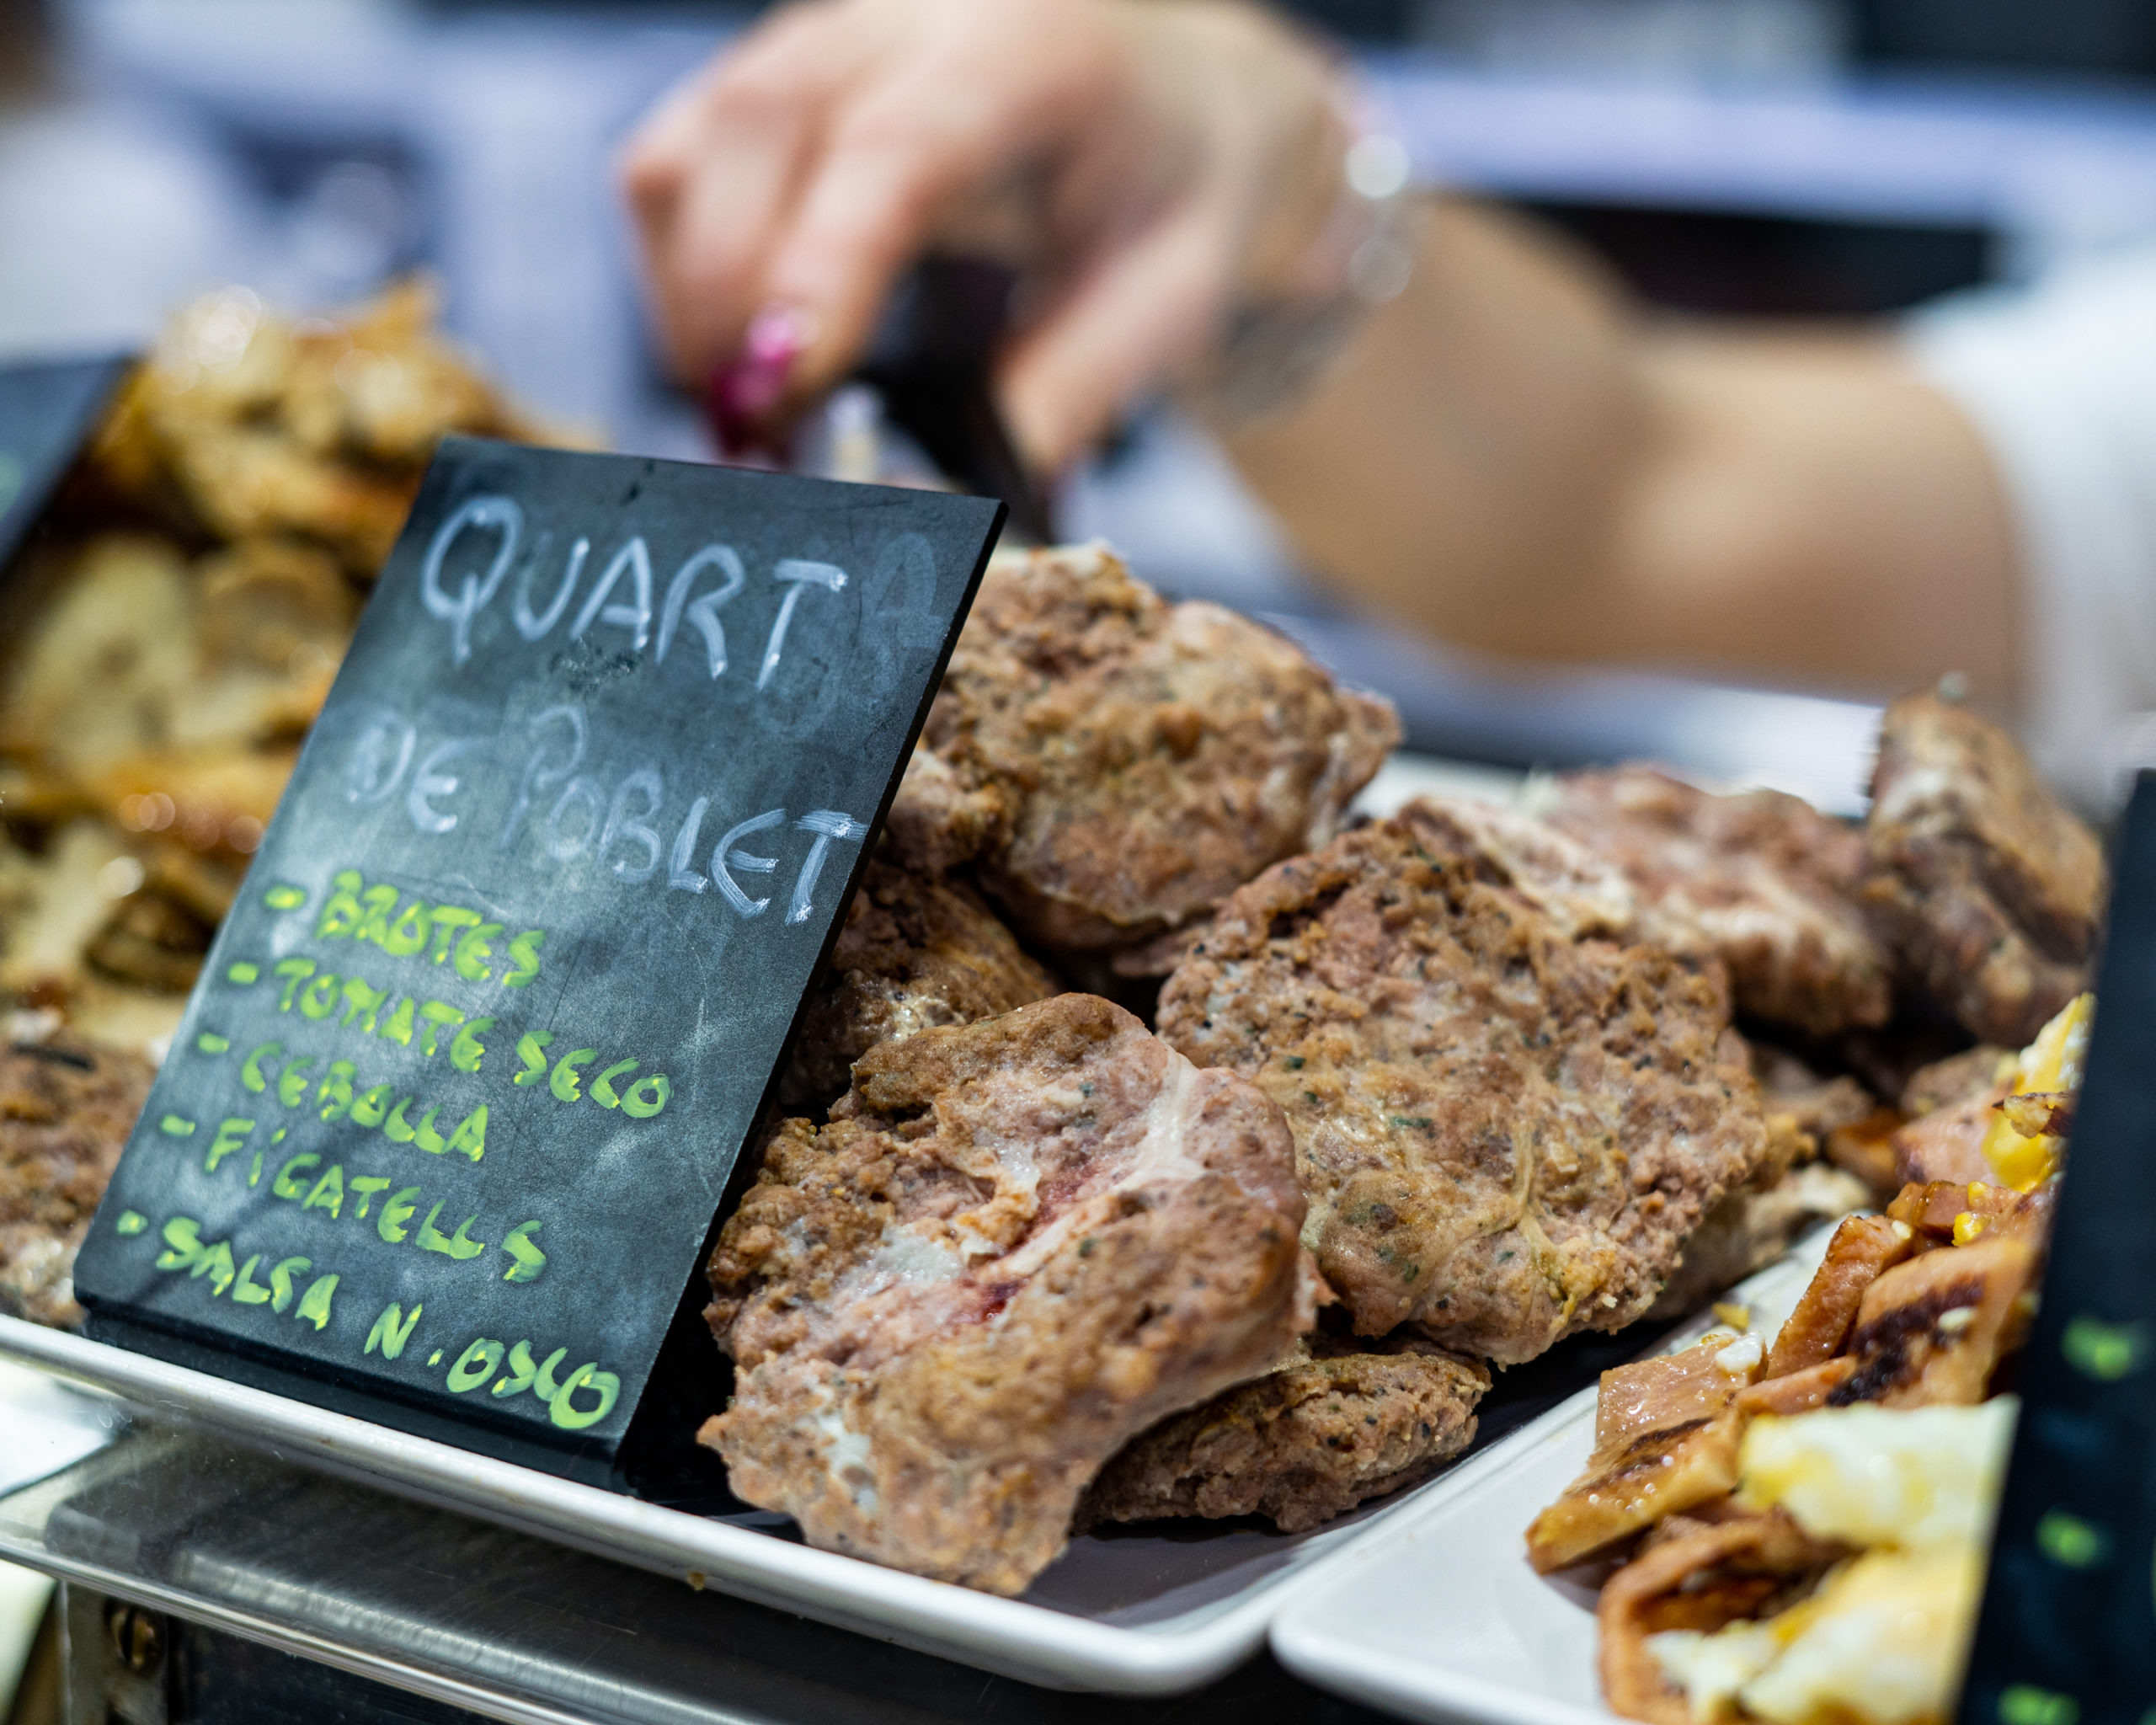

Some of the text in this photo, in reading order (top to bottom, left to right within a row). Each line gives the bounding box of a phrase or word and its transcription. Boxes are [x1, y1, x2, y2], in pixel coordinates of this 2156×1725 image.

[422, 493, 849, 692] QUART
[344, 702, 868, 927] DE POBLET
[314, 869, 546, 988] BROTES
[241, 1041, 489, 1162] CEBOLLA
[274, 959, 670, 1119] TOMATE SECO
[156, 1216, 340, 1330] SALSA
